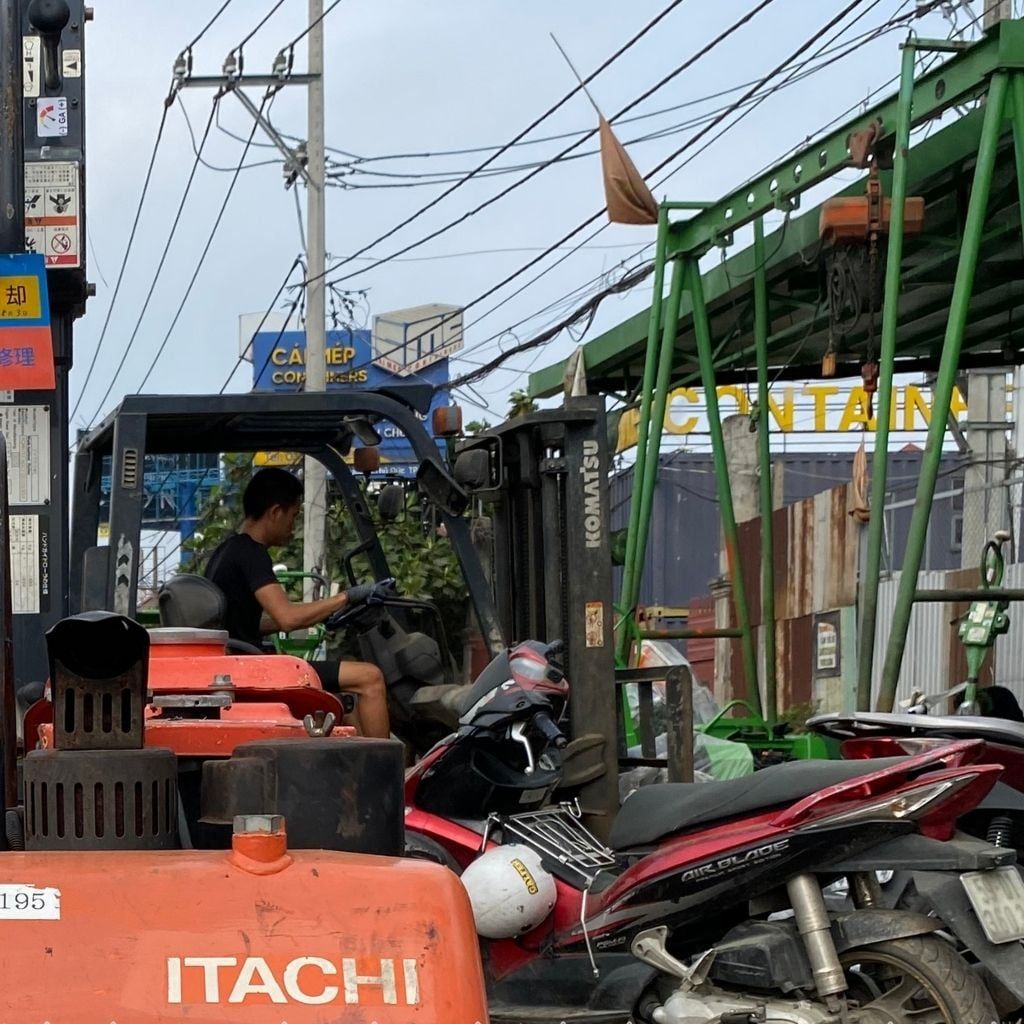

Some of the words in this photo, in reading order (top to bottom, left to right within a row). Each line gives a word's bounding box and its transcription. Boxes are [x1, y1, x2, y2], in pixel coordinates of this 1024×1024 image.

[585, 440, 599, 548] KOMATSU
[717, 839, 790, 870] BLADE
[167, 956, 420, 1005] ITACHI
